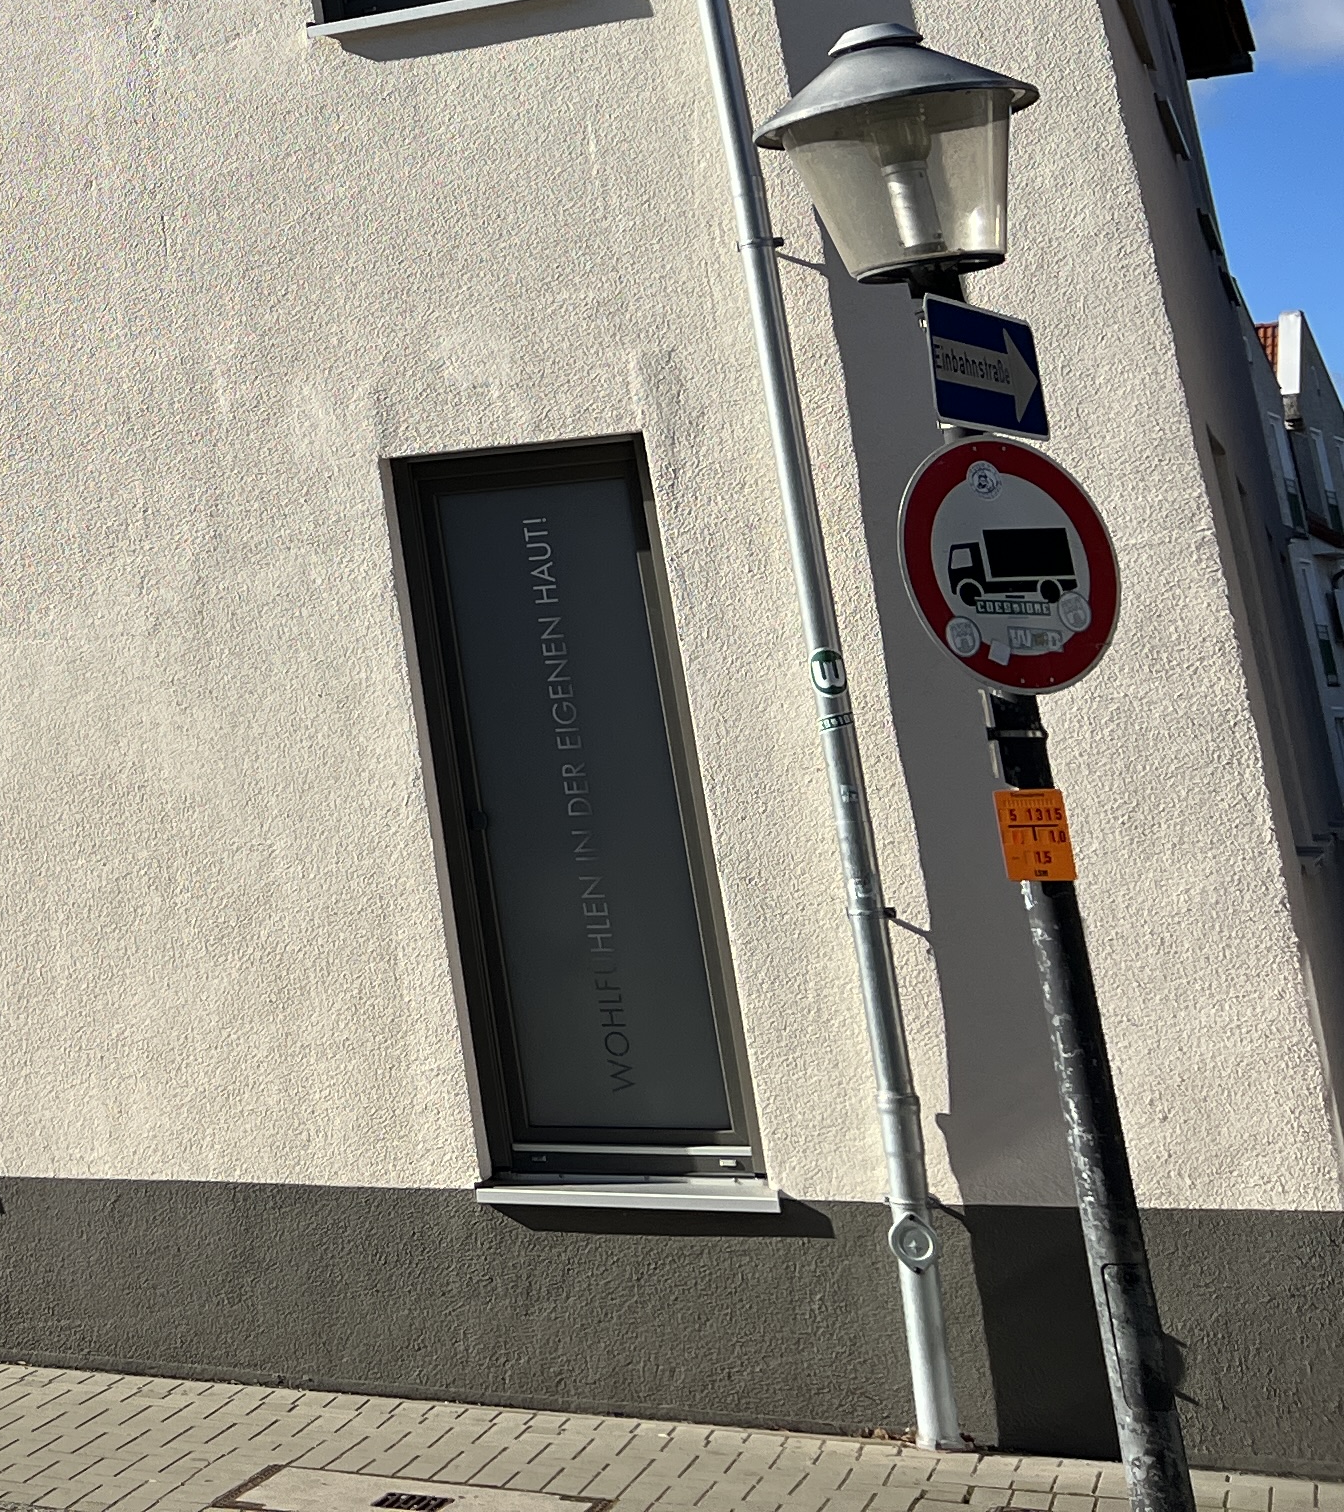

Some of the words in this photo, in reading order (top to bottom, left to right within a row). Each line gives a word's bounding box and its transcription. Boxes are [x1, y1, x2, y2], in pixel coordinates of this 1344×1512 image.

[933, 343, 1011, 385] Einbahnstraße
[522, 517, 560, 605] HAUT!
[538, 616, 584, 752] EIGENEN
[562, 761, 595, 818] DER
[1026, 808, 1062, 821] 1315
[570, 828, 600, 863] IN
